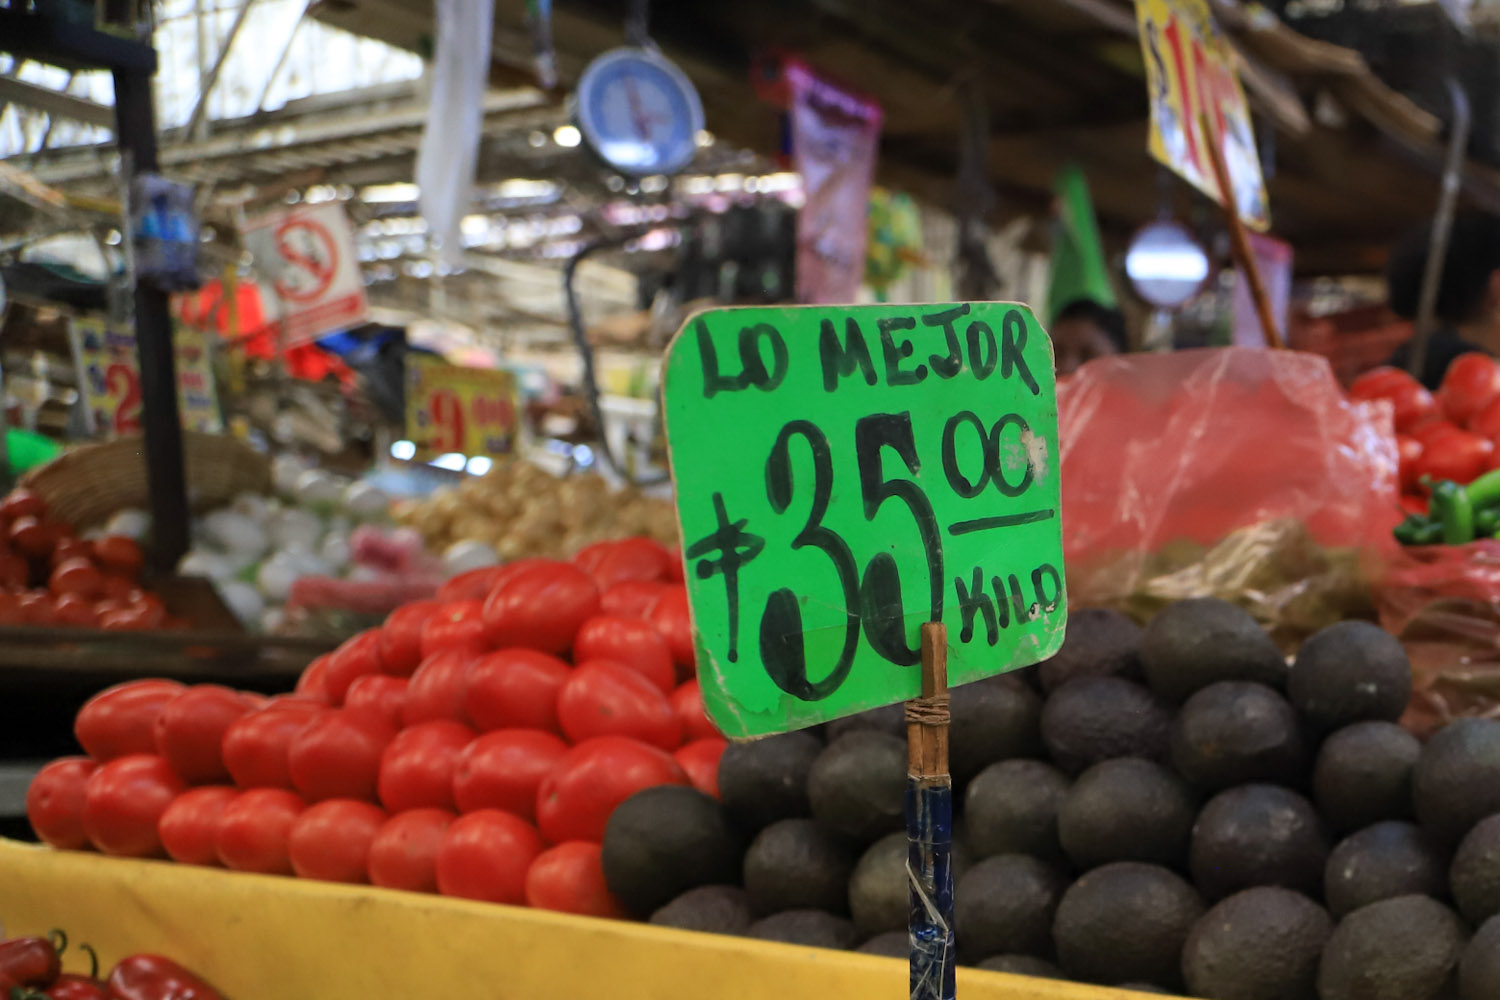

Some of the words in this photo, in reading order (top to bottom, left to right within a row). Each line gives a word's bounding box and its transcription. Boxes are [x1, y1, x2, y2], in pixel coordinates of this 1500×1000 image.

[696, 318, 790, 399] LO
[819, 303, 1040, 396] MEJOR
[954, 563, 1063, 648] KILO
